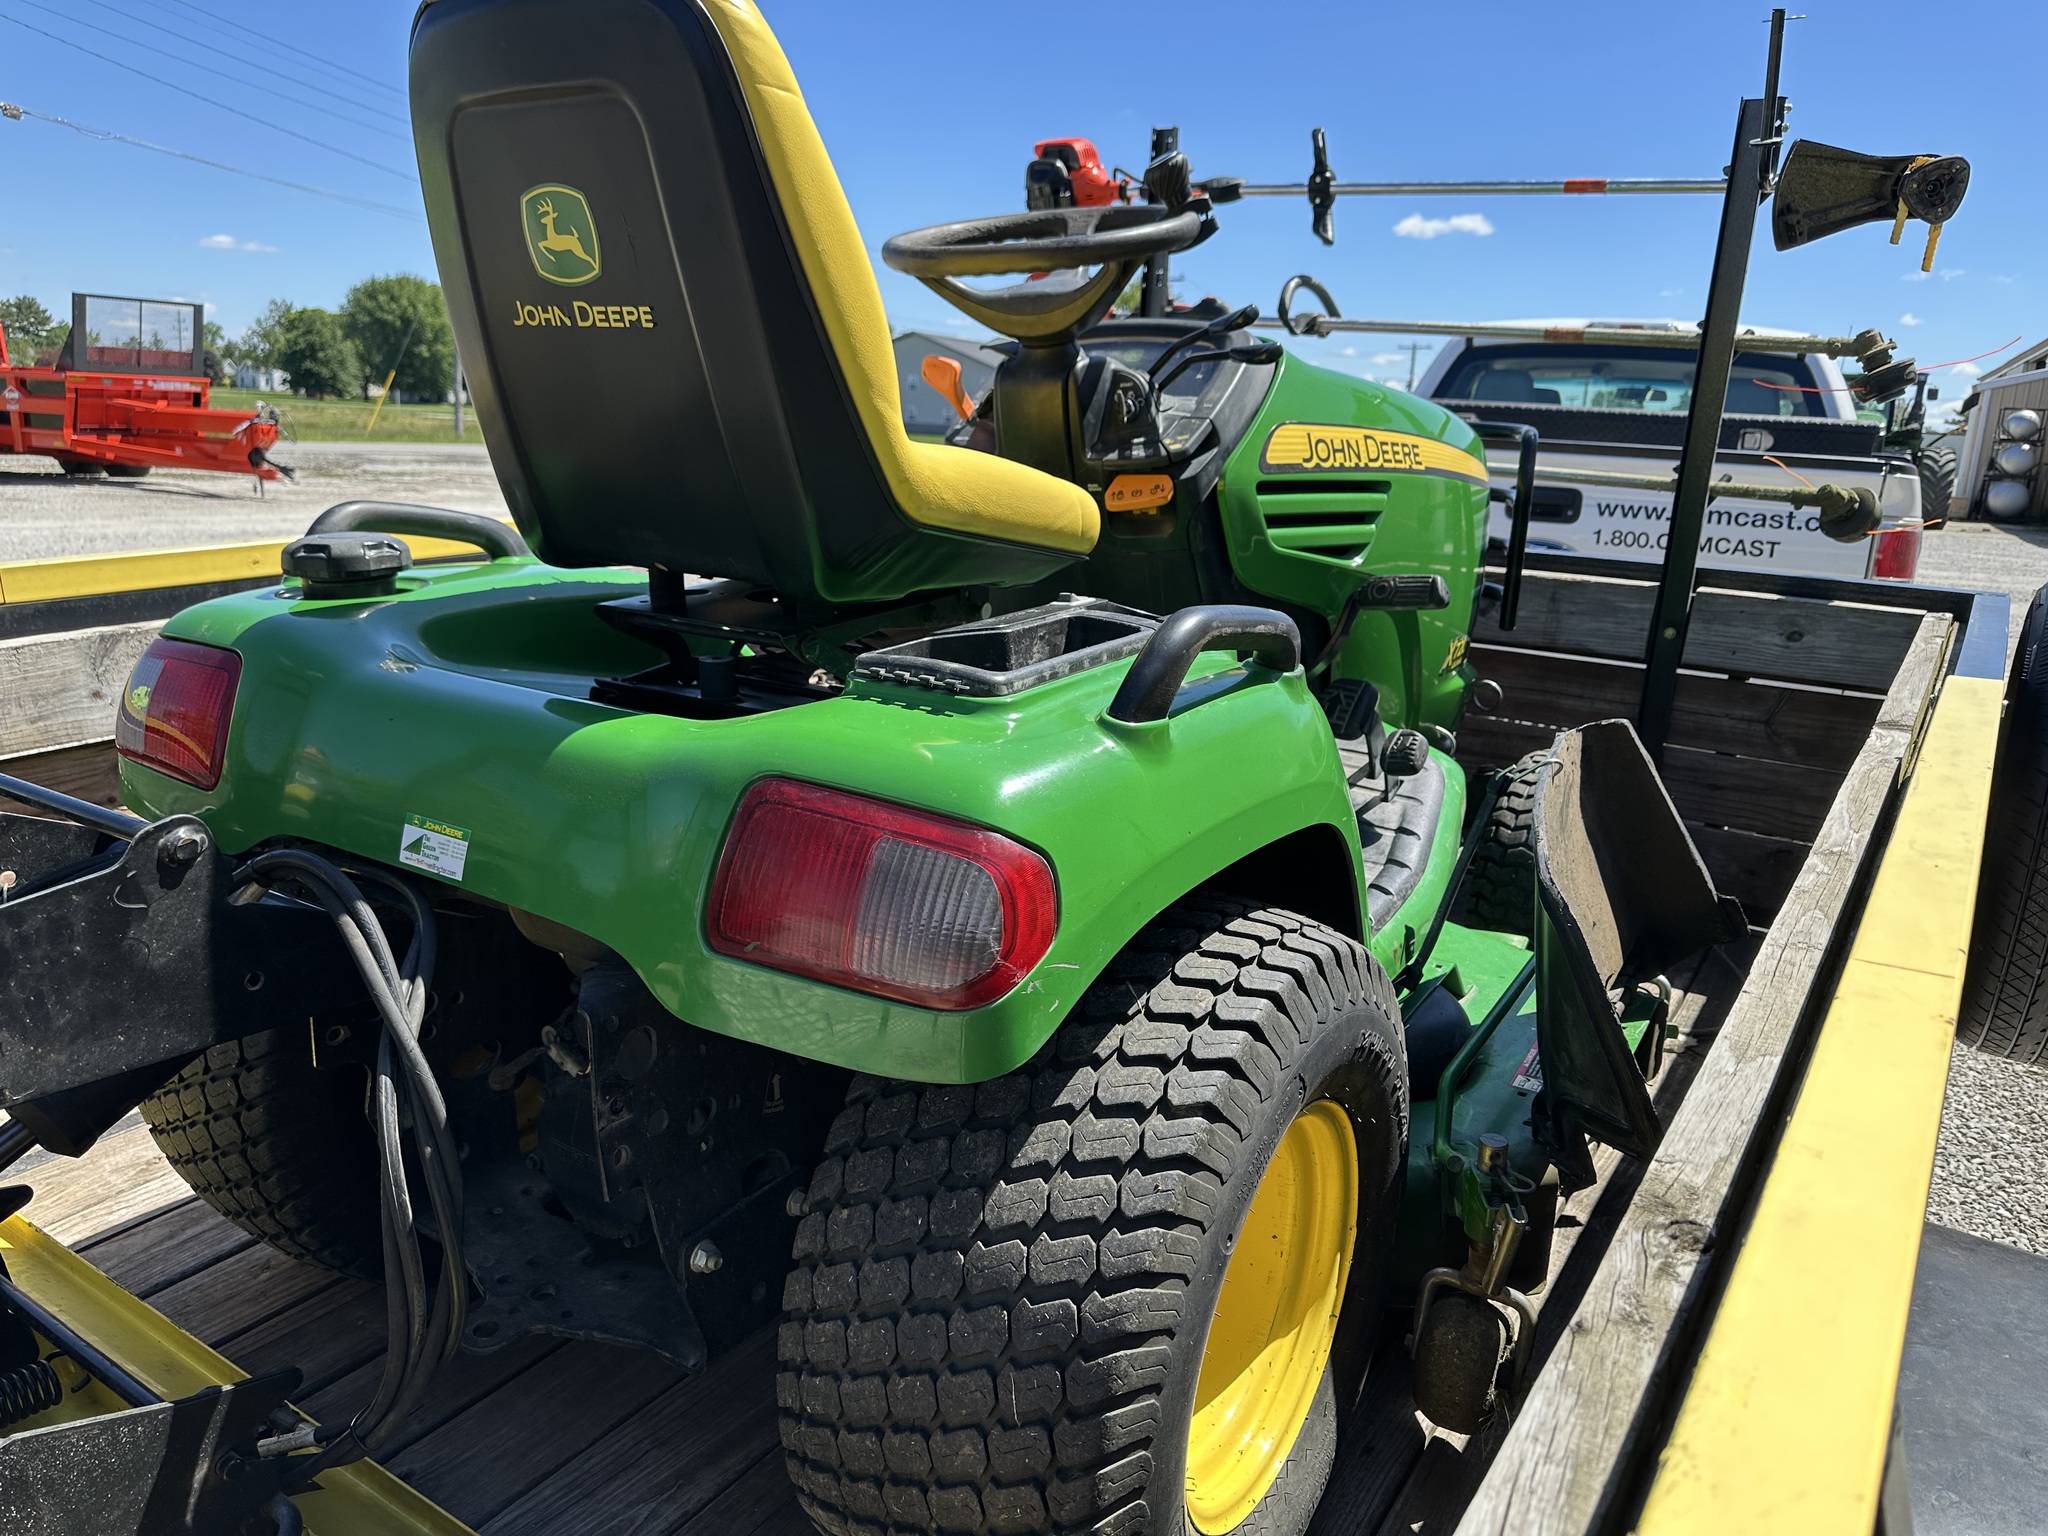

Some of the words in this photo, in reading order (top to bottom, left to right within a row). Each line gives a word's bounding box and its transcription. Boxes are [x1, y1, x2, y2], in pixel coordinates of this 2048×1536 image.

[513, 300, 572, 327] JOHN
[1302, 432, 1362, 464] JOHN
[1363, 434, 1423, 467] DEERE
[1593, 529, 1781, 559] 1.800.CMCAST
[423, 820, 442, 832] JOHN
[442, 825, 464, 839] DEERE
[421, 850, 440, 862] TRACTOR
